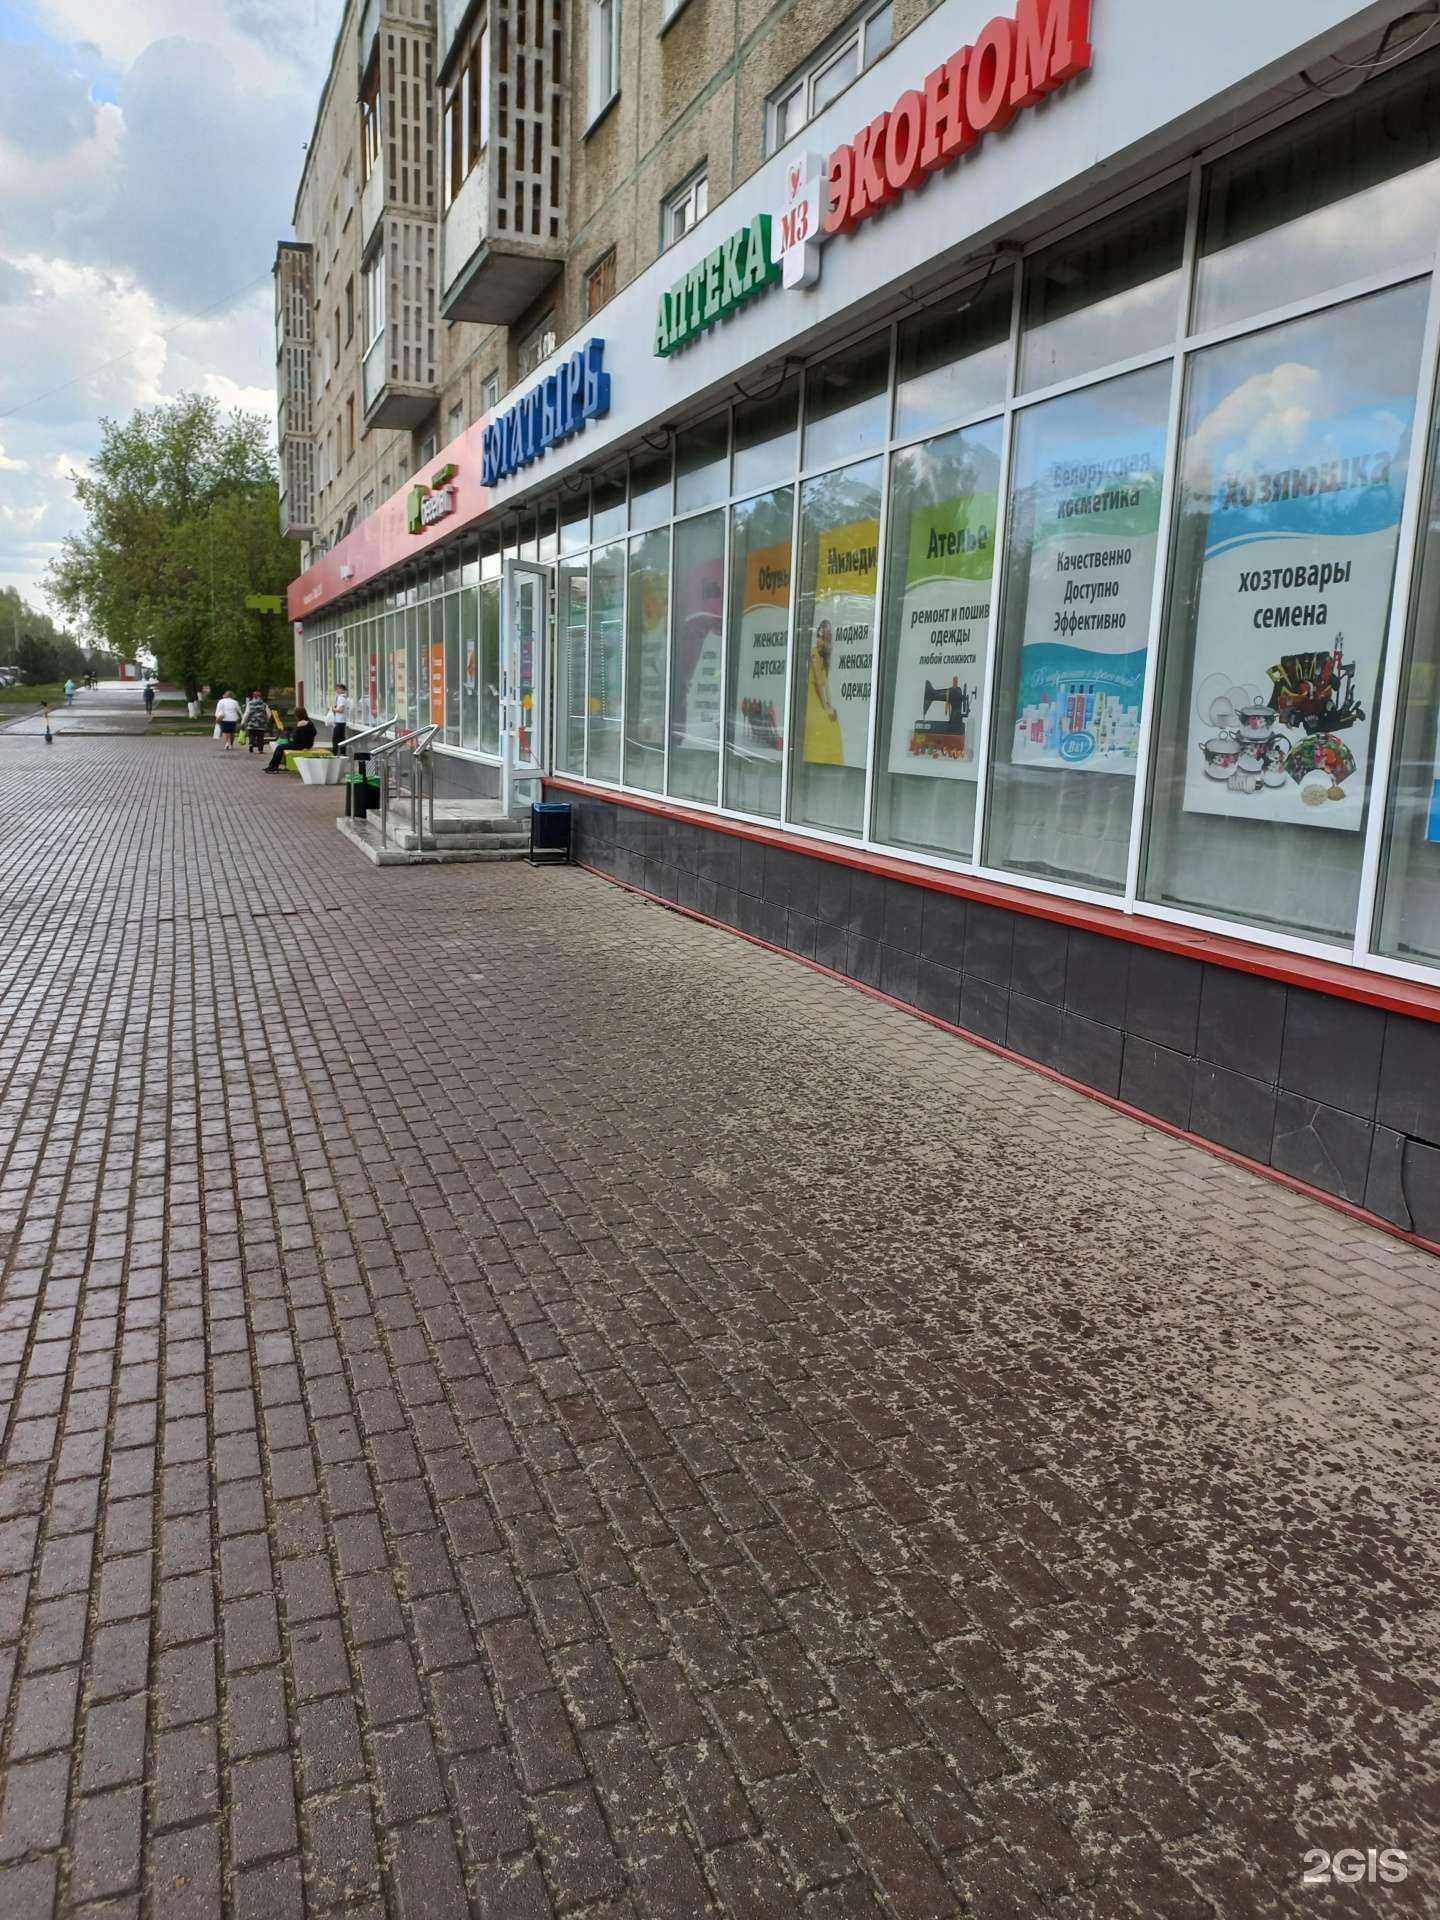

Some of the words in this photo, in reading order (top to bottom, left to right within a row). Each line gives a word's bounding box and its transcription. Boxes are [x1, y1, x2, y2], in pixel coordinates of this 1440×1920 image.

[653, 213, 778, 357] АПТЕКА
[823, 0, 1092, 234] ЭКОНОМ
[480, 338, 611, 487] БОГАТЫРЬ
[1057, 488, 1140, 519] косметика
[926, 524, 988, 559] Ателье
[1057, 548, 1132, 572] Качественно
[1238, 561, 1352, 592] хозтовары
[1064, 579, 1119, 604] Доступно
[911, 607, 950, 628] ремонт
[951, 607, 957, 620] и
[959, 603, 990, 621] пошив
[1053, 611, 1126, 636] Эффективно
[1253, 603, 1328, 628] семена
[835, 624, 869, 645] модная
[930, 627, 971, 646] одежды
[838, 653, 873, 669] женская
[919, 652, 942, 665] любой
[943, 653, 977, 664] сложности
[841, 682, 871, 700] одежда
